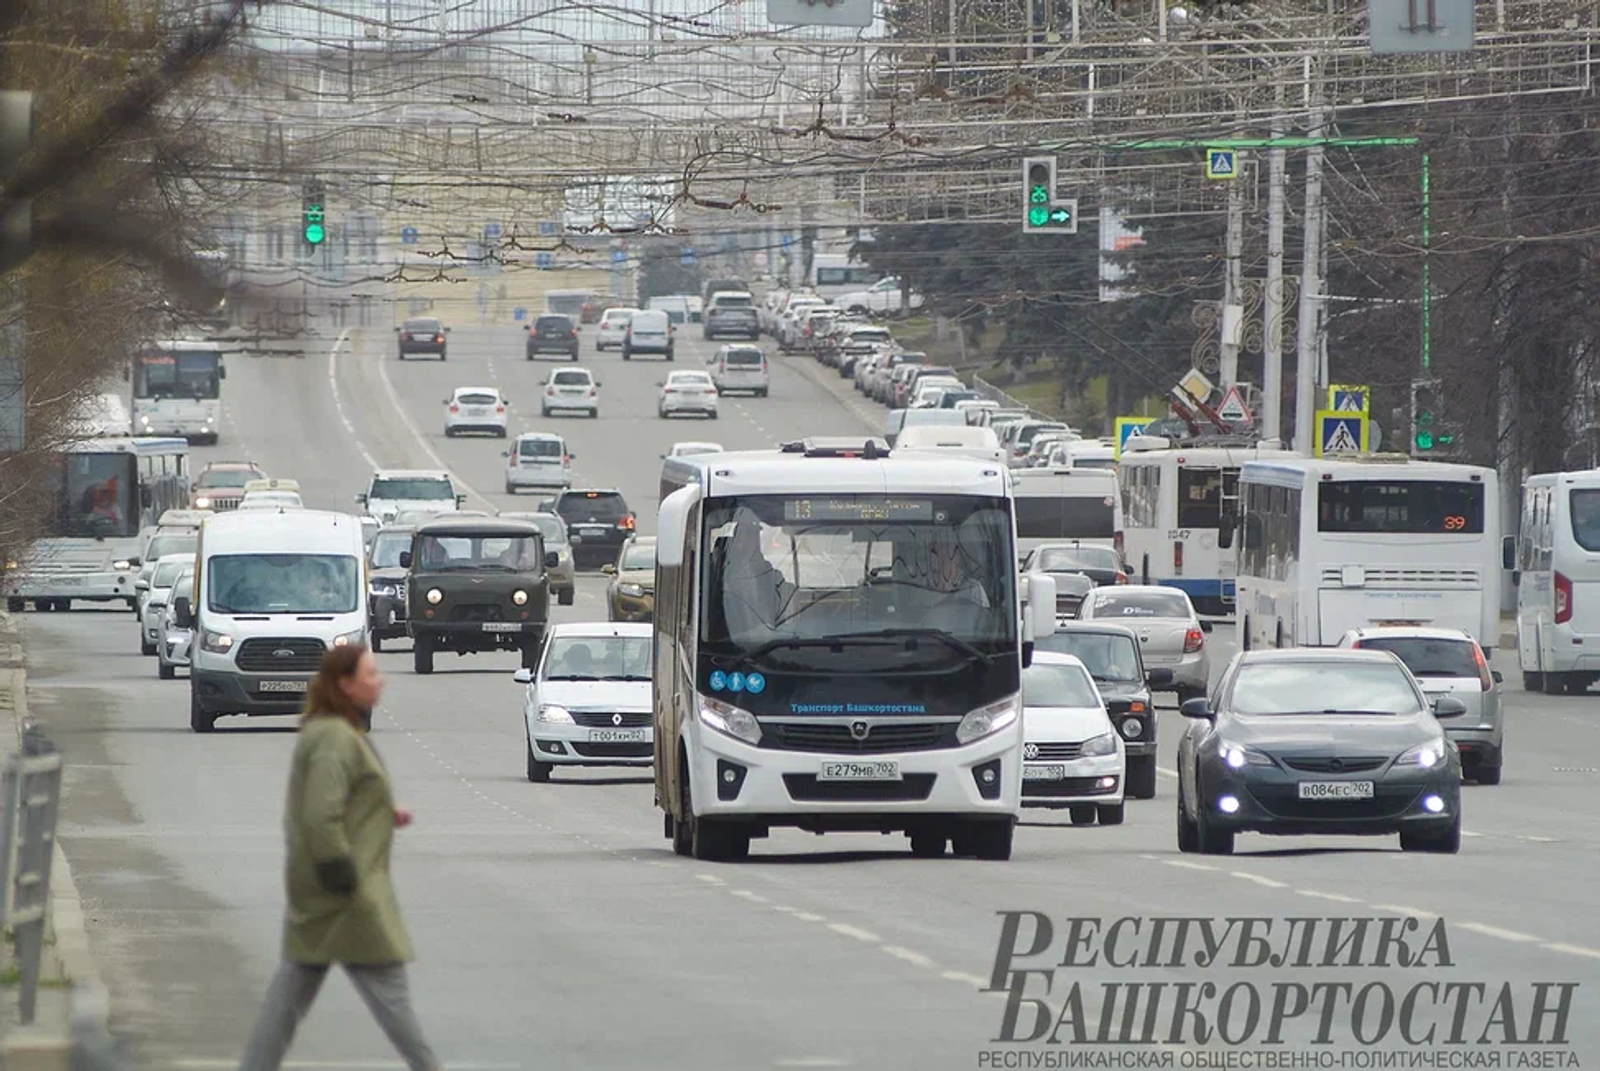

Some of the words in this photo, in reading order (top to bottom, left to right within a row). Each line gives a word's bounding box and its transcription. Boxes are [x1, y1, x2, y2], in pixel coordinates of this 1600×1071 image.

[1445, 516, 1465, 529] 39
[791, 703, 844, 714] Транспорт
[846, 703, 925, 713] Башкортостана
